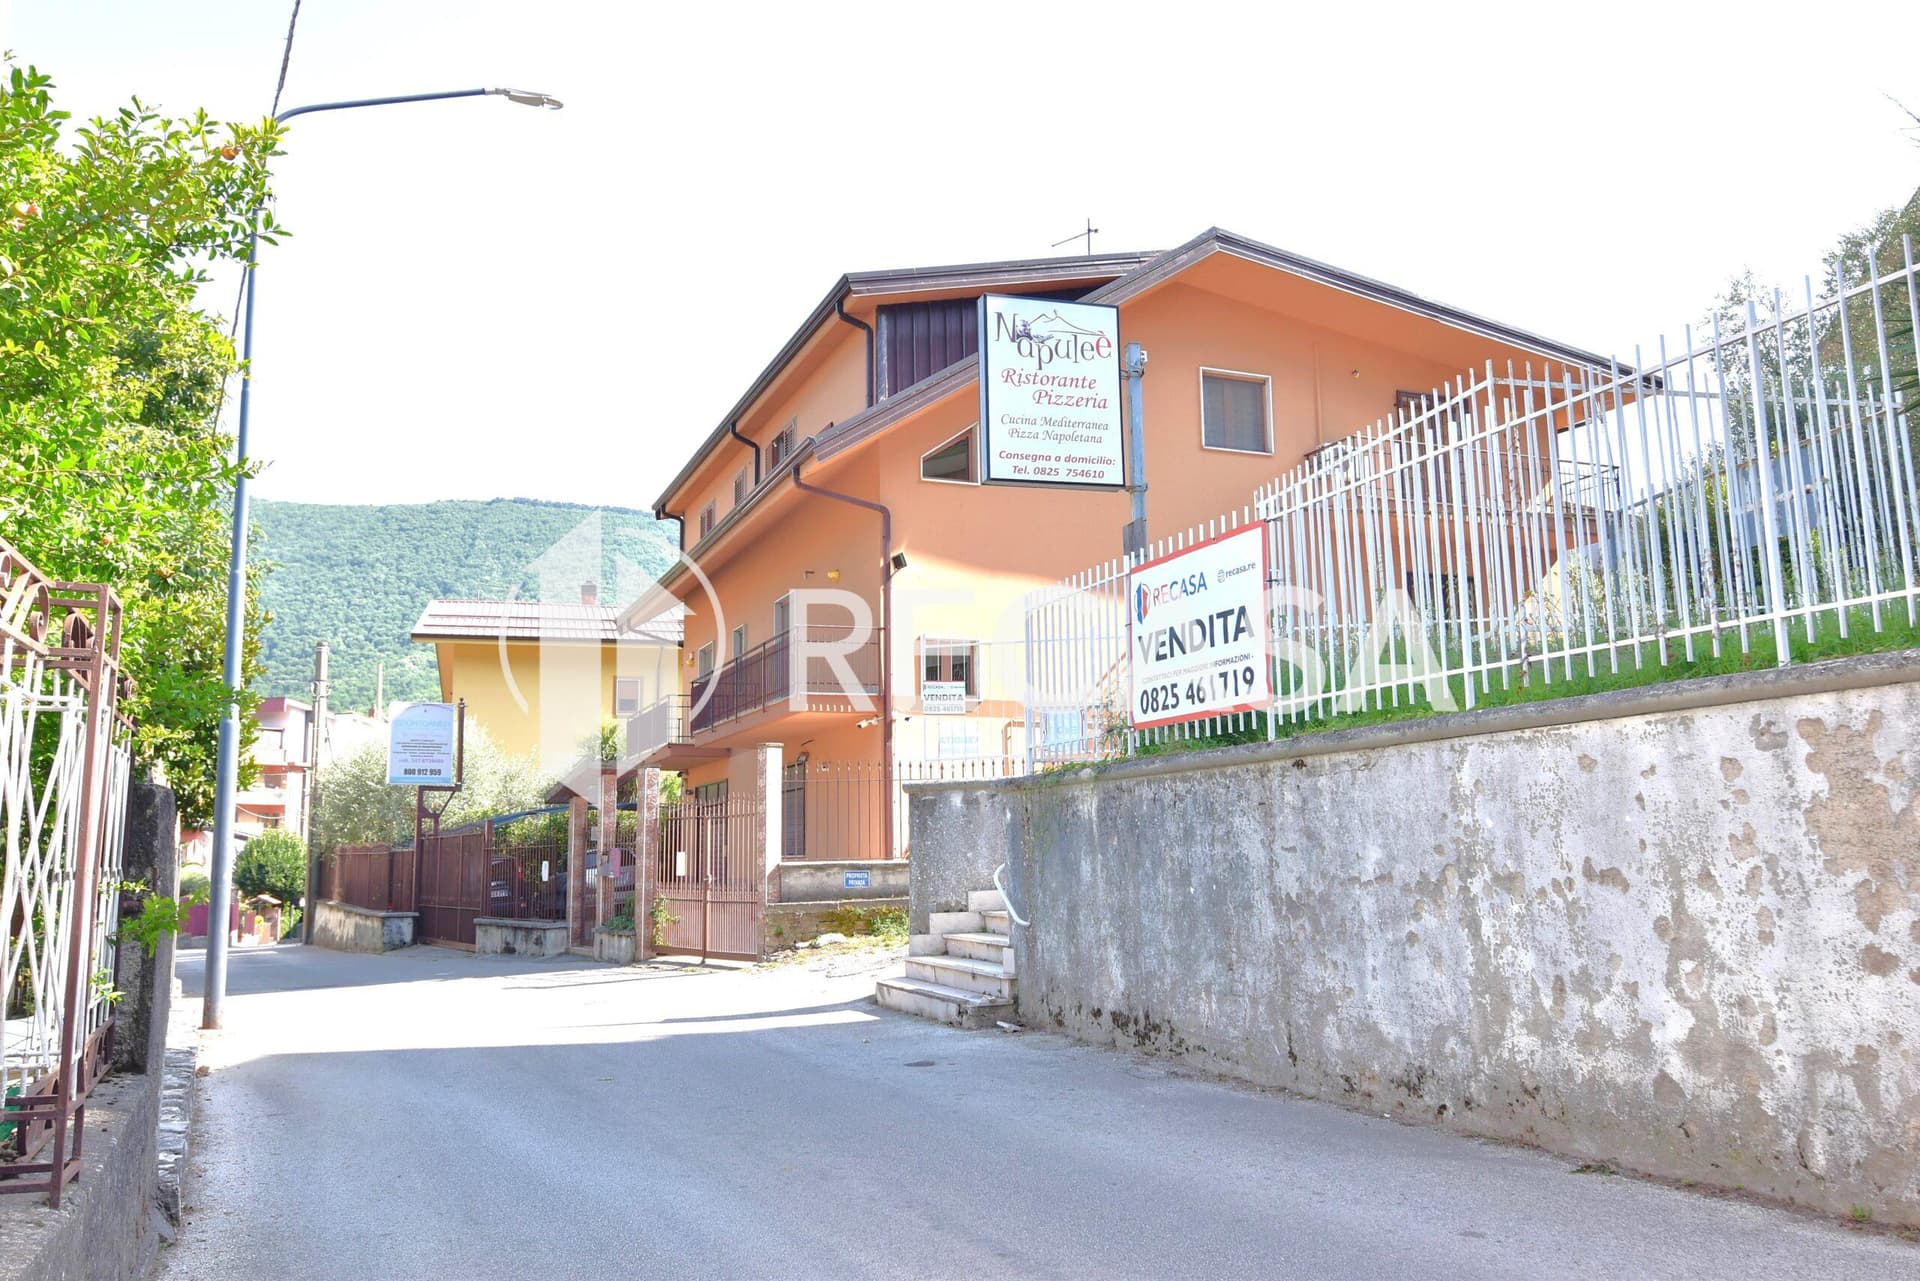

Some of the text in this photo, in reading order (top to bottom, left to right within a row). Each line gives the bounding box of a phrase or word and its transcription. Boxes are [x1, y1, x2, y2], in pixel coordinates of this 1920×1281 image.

[1001, 367, 1097, 390] Ristorante
[1032, 389, 1108, 409] Pizzeria
[1000, 413, 1109, 431] Cucina Mediterranea
[1008, 427, 1103, 444] Pizza Napoletana
[999, 450, 1116, 466] Consegna a domicilio:
[1012, 465, 1105, 479] Tel. 0825 754610
[1153, 571, 1208, 607] RECASA
[1138, 605, 1255, 665] VENDITA
[1210, 652, 1251, 668] FORMAZIONI
[923, 693, 964, 701] VENDITA
[1140, 666, 1255, 715] 0825 461719
